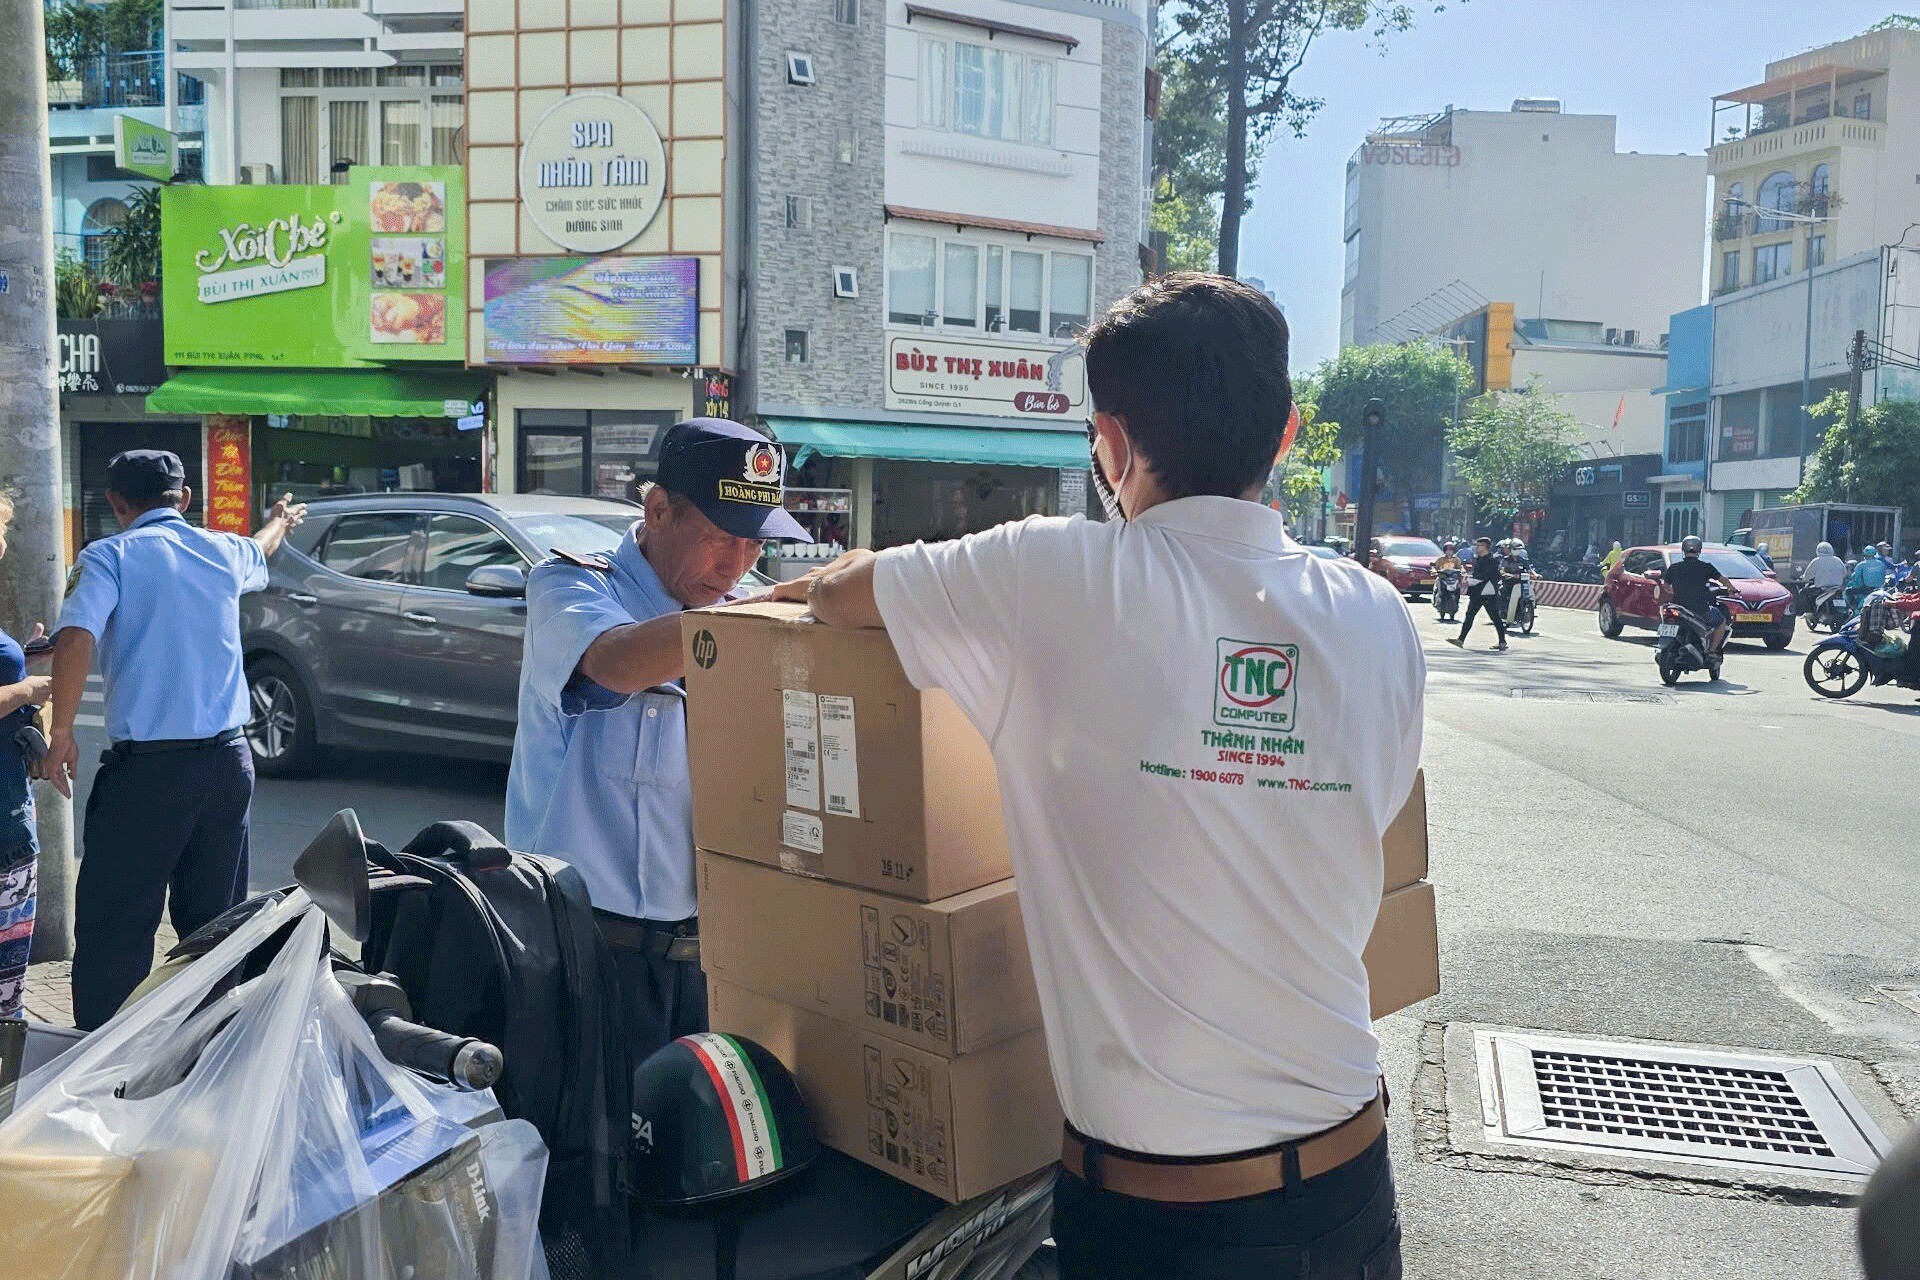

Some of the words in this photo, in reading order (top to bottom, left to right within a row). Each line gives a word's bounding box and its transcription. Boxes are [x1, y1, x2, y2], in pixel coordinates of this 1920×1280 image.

[571, 121, 613, 148] SPA
[537, 156, 592, 188] NHÂN
[601, 154, 648, 186] TÂM
[576, 197, 594, 211] SÓC
[598, 196, 617, 210] SỨC
[601, 219, 623, 232] SINH
[203, 281, 227, 298] BÙI
[232, 279, 254, 292] THỊ
[260, 271, 299, 288] XUÂN
[895, 347, 938, 373] BÙI
[944, 356, 983, 380] THỊ
[988, 358, 1043, 381] XUÂN
[919, 381, 945, 390] SINCE
[949, 383, 969, 391] 1995
[1024, 394, 1046, 411] Bún
[1047, 394, 1060, 411] bò
[723, 484, 757, 500] HOÀNG
[758, 492, 771, 503] PHI
[694, 629, 716, 669] hp
[1224, 656, 1287, 697] TNC
[1220, 706, 1288, 724] COMPUTER
[1201, 729, 1256, 751] THÀNH
[1217, 750, 1253, 765] SINCE
[1256, 753, 1286, 767] 1994
[1140, 760, 1187, 779] Hotline:
[1189, 769, 1217, 783] 1900
[1218, 772, 1244, 785] 6078
[1257, 777, 1352, 793] www.TNC.com.vn
[731, 1070, 746, 1095] PIAGGIO
[747, 1111, 760, 1142] PIAGGIO
[465, 1161, 491, 1224] D-Link
